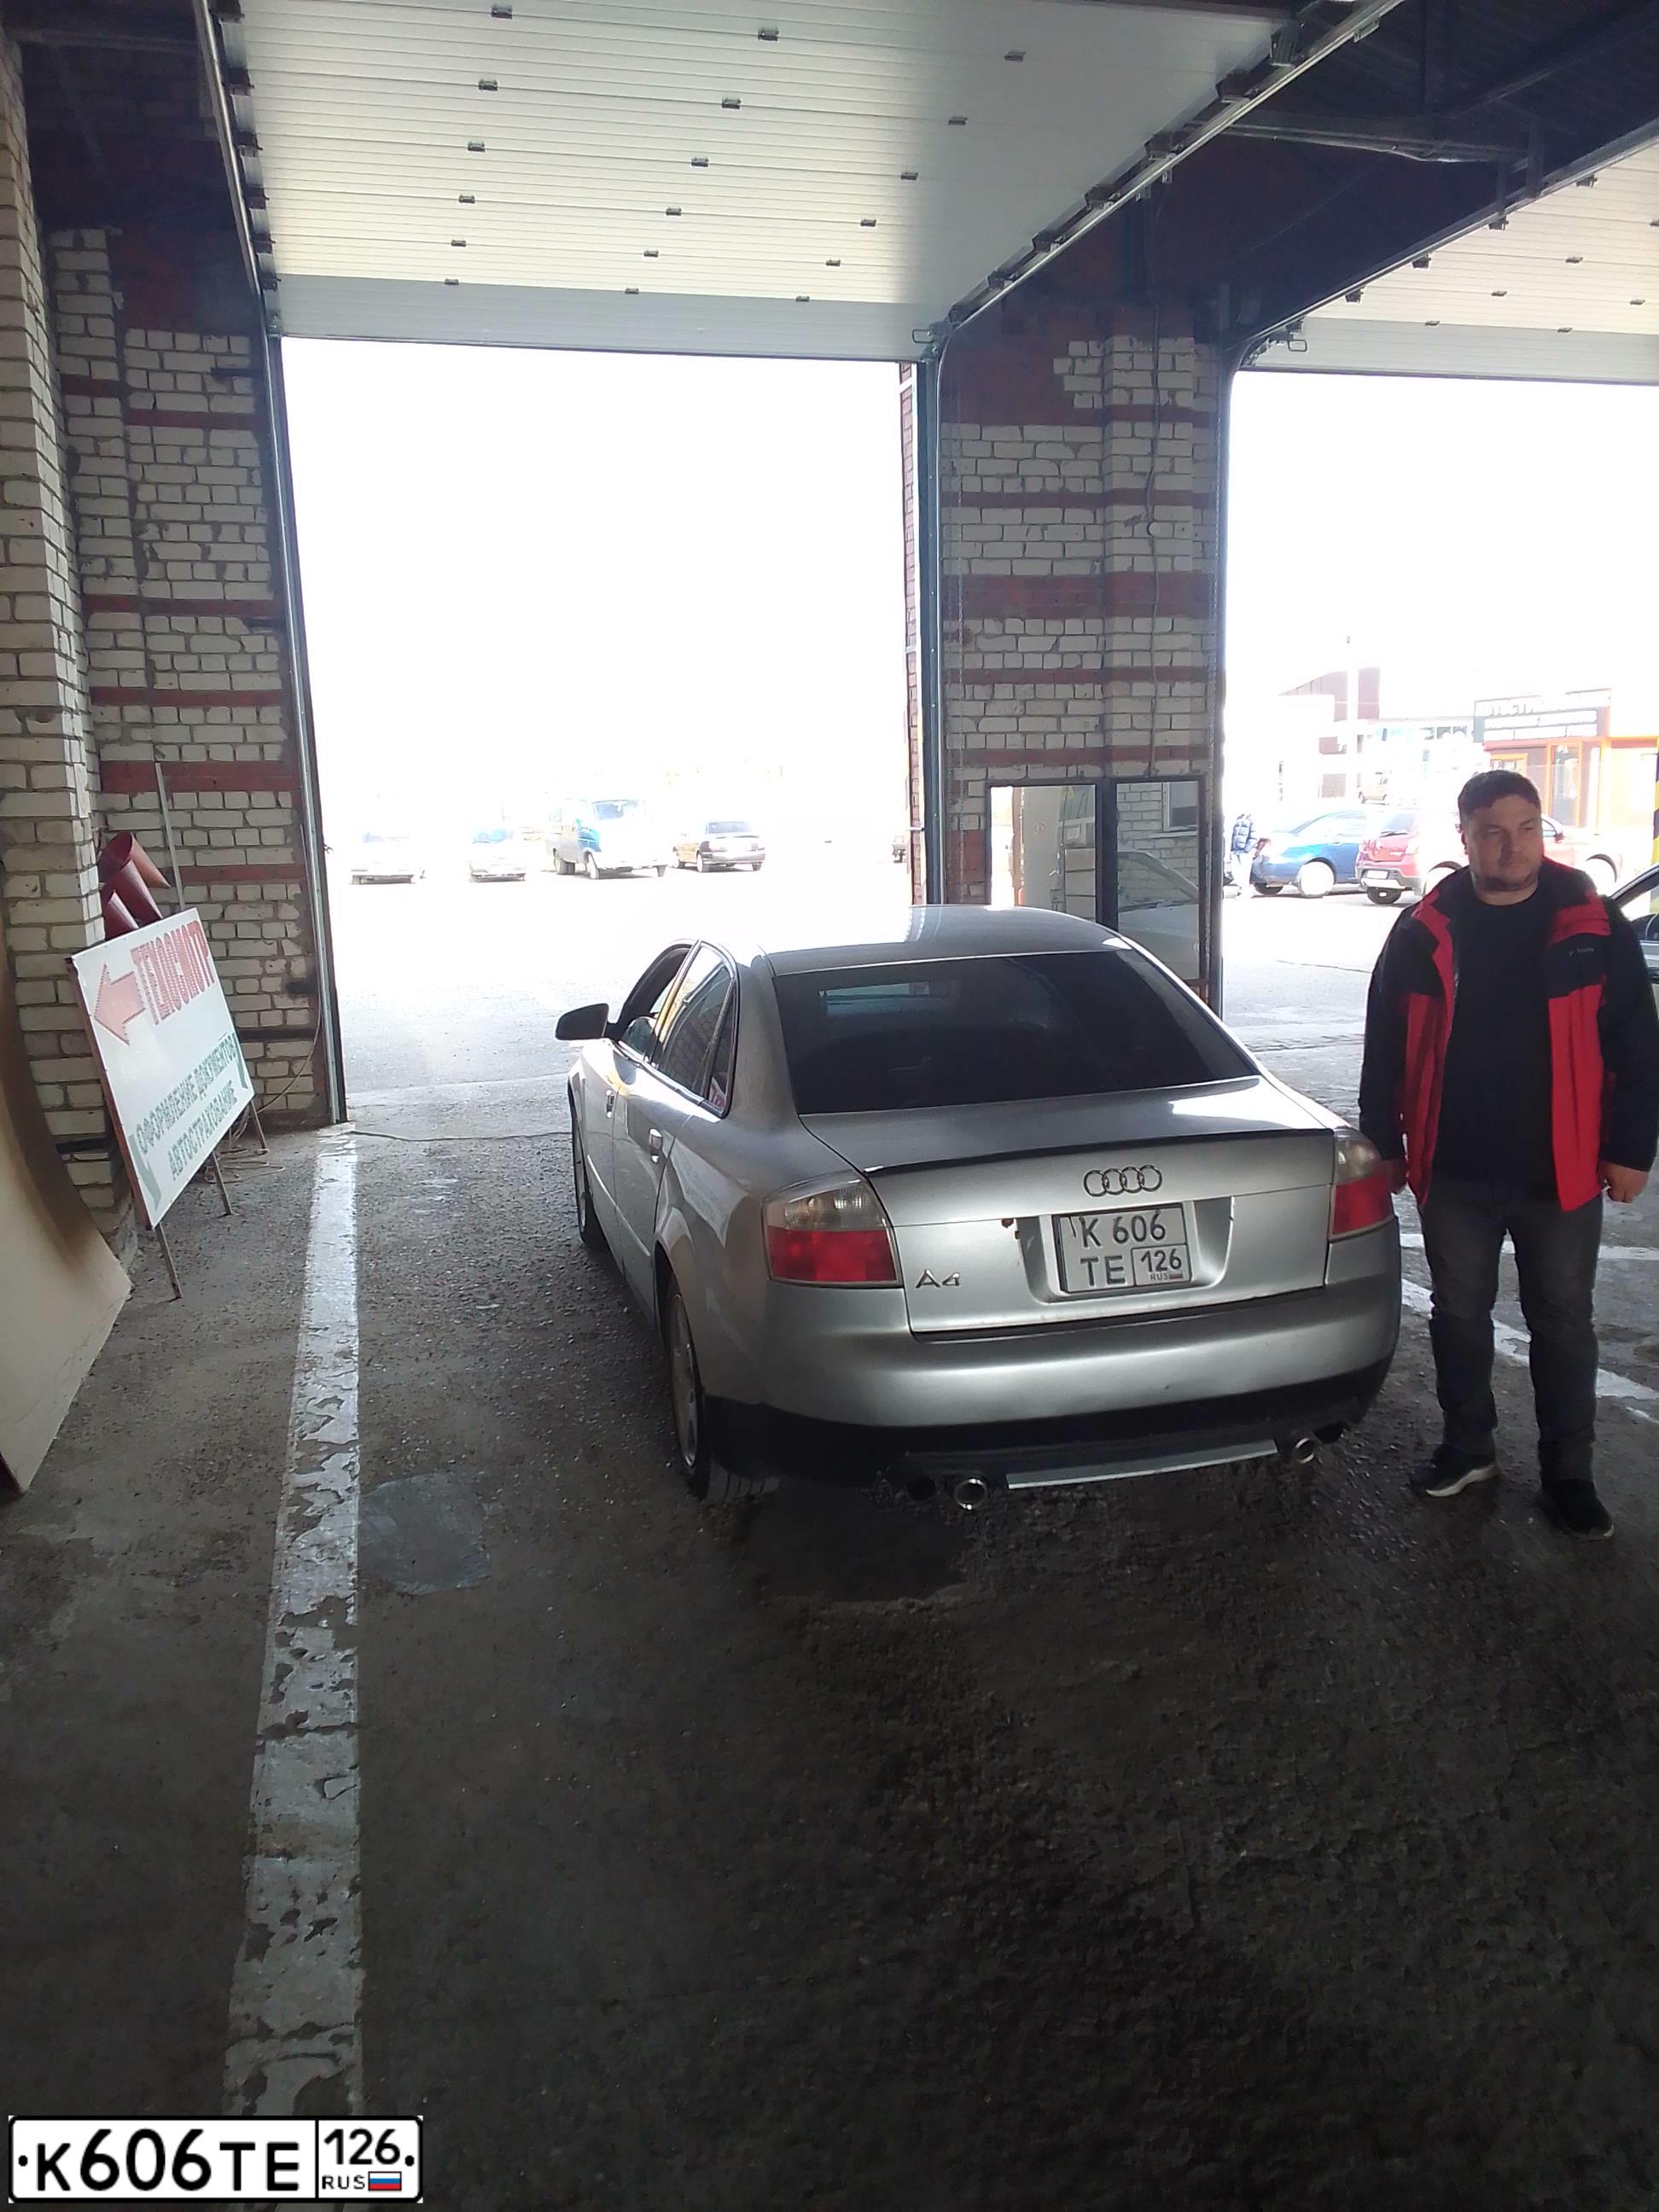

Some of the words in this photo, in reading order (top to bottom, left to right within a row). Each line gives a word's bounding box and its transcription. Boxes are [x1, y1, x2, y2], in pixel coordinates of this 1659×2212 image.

[130, 920, 215, 1026] ТЕХОСМОТР
[137, 1074, 198, 1155] ОФОРМЛЕНИЕ
[194, 1033, 236, 1101] ДОКУМЕНТОВ
[167, 1079, 238, 1181] АВТОСТРАХОВАНИЕ
[1113, 1209, 1166, 1244] 606
[1080, 1255, 1126, 1286] ТЕ
[1140, 1249, 1182, 1272] 126
[1150, 1272, 1169, 1280] RUS
[915, 1269, 962, 1289] A4
